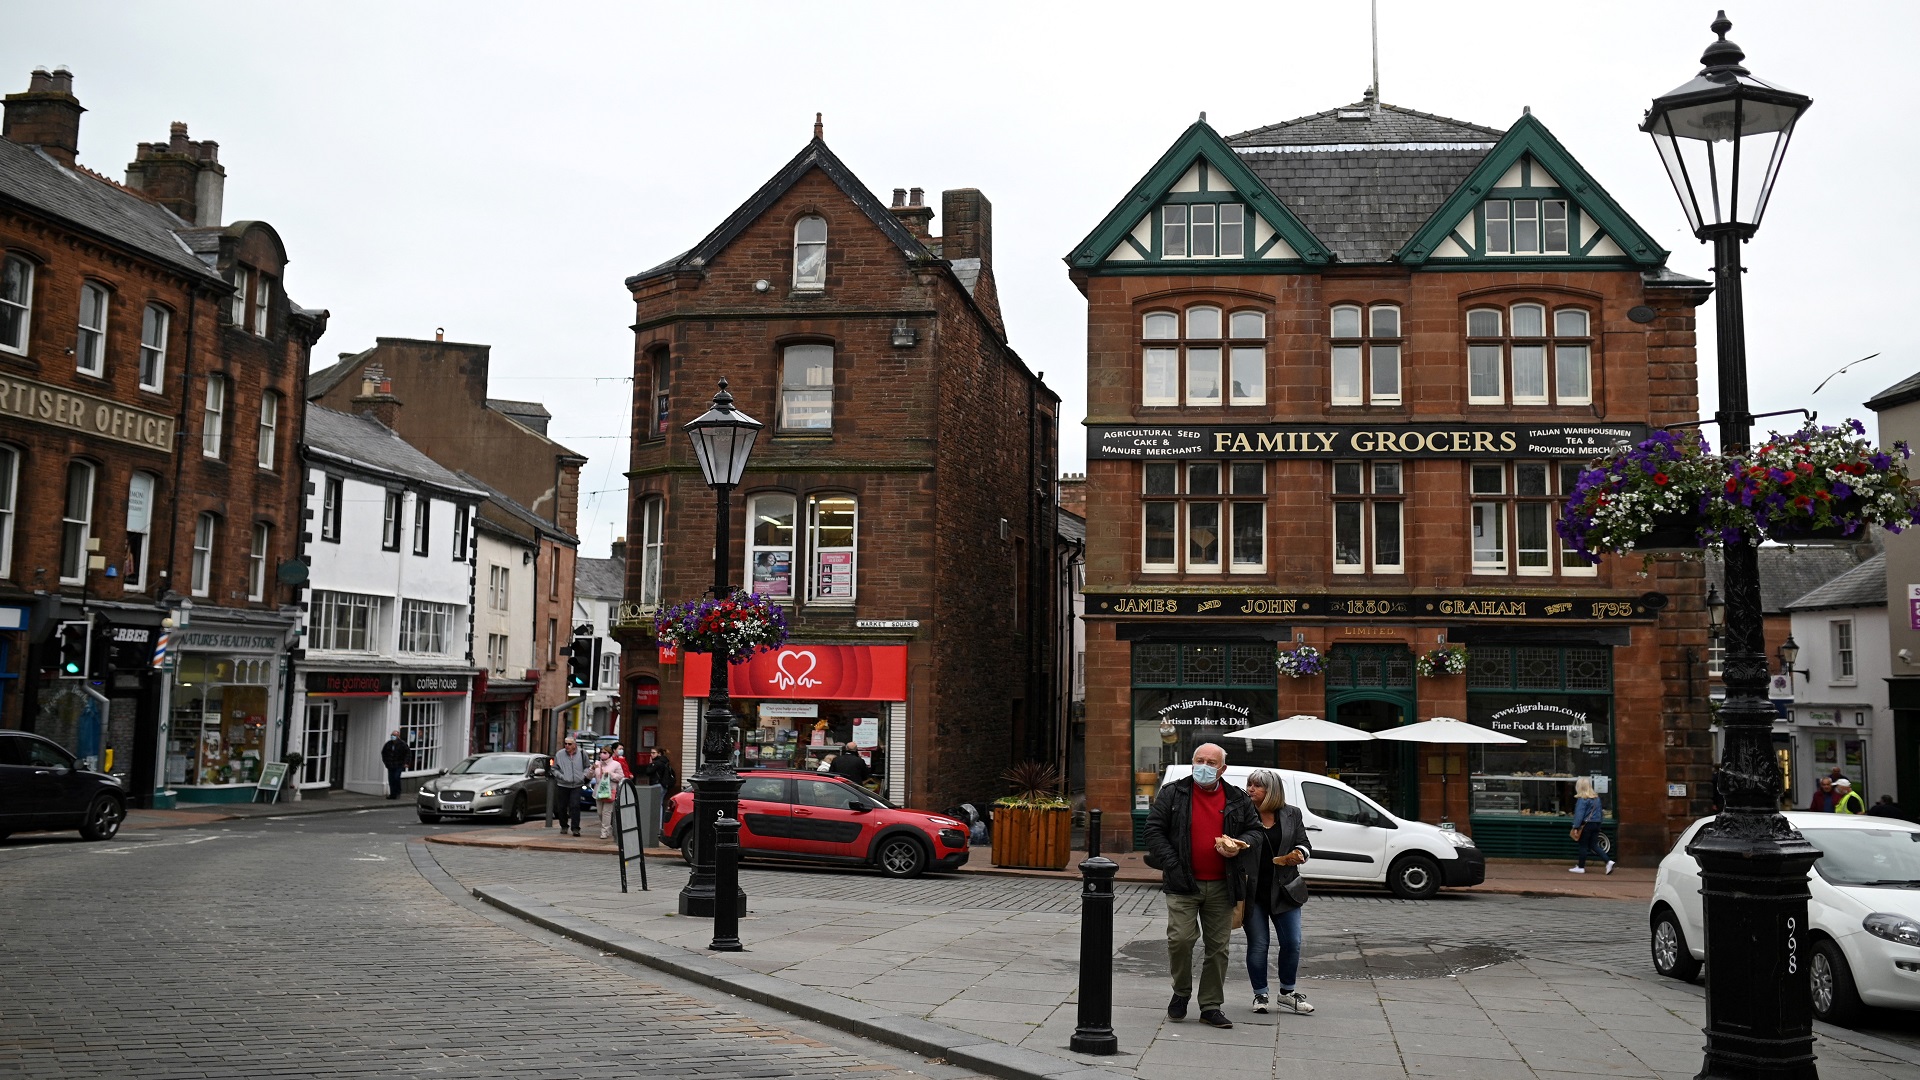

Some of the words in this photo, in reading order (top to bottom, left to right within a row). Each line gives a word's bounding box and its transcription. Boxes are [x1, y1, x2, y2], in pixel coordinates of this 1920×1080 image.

[95, 405, 166, 446] OFFICE
[1529, 428, 1560, 437] ITALIAN
[1563, 427, 1632, 437] WAREHOUSEMEN
[1103, 429, 1173, 439] AGRICULTURAL
[1177, 430, 1201, 439] SEED
[1565, 436, 1583, 445] TEA
[1587, 436, 1595, 445] &
[1133, 438, 1158, 446] CAKE
[1162, 438, 1170, 446] &
[1213, 431, 1339, 452] FAMILY
[1350, 431, 1517, 452] GROCERS
[1102, 445, 1142, 455] MANURE
[1146, 445, 1202, 455] MERCHANTS
[1528, 444, 1575, 455] PROVISION
[1578, 444, 1633, 455] MERCHNTS
[1113, 598, 1178, 613] JAMES
[1197, 599, 1222, 613] AND
[1240, 598, 1298, 614] JOHN
[1347, 600, 1391, 614] 1880
[1439, 600, 1526, 615] GRAHAM
[1591, 602, 1633, 620] 1793
[182, 633, 219, 647] NATURES
[219, 634, 251, 648] HEALTH
[252, 636, 277, 648] STORE
[342, 677, 380, 692] gathering
[416, 676, 438, 690] coffee
[438, 677, 457, 689] house
[1158, 698, 1250, 716] www.jjgraham.co.uk
[1491, 702, 1587, 721] www.jjgraham.co.uk
[1160, 716, 1192, 725] Artisan
[1194, 717, 1218, 725] Baker
[1492, 721, 1512, 730] Fine
[1513, 721, 1535, 730] Food
[1536, 722, 1545, 730] &
[1546, 722, 1588, 732] Hampers
[1787, 917, 1797, 974] 998
